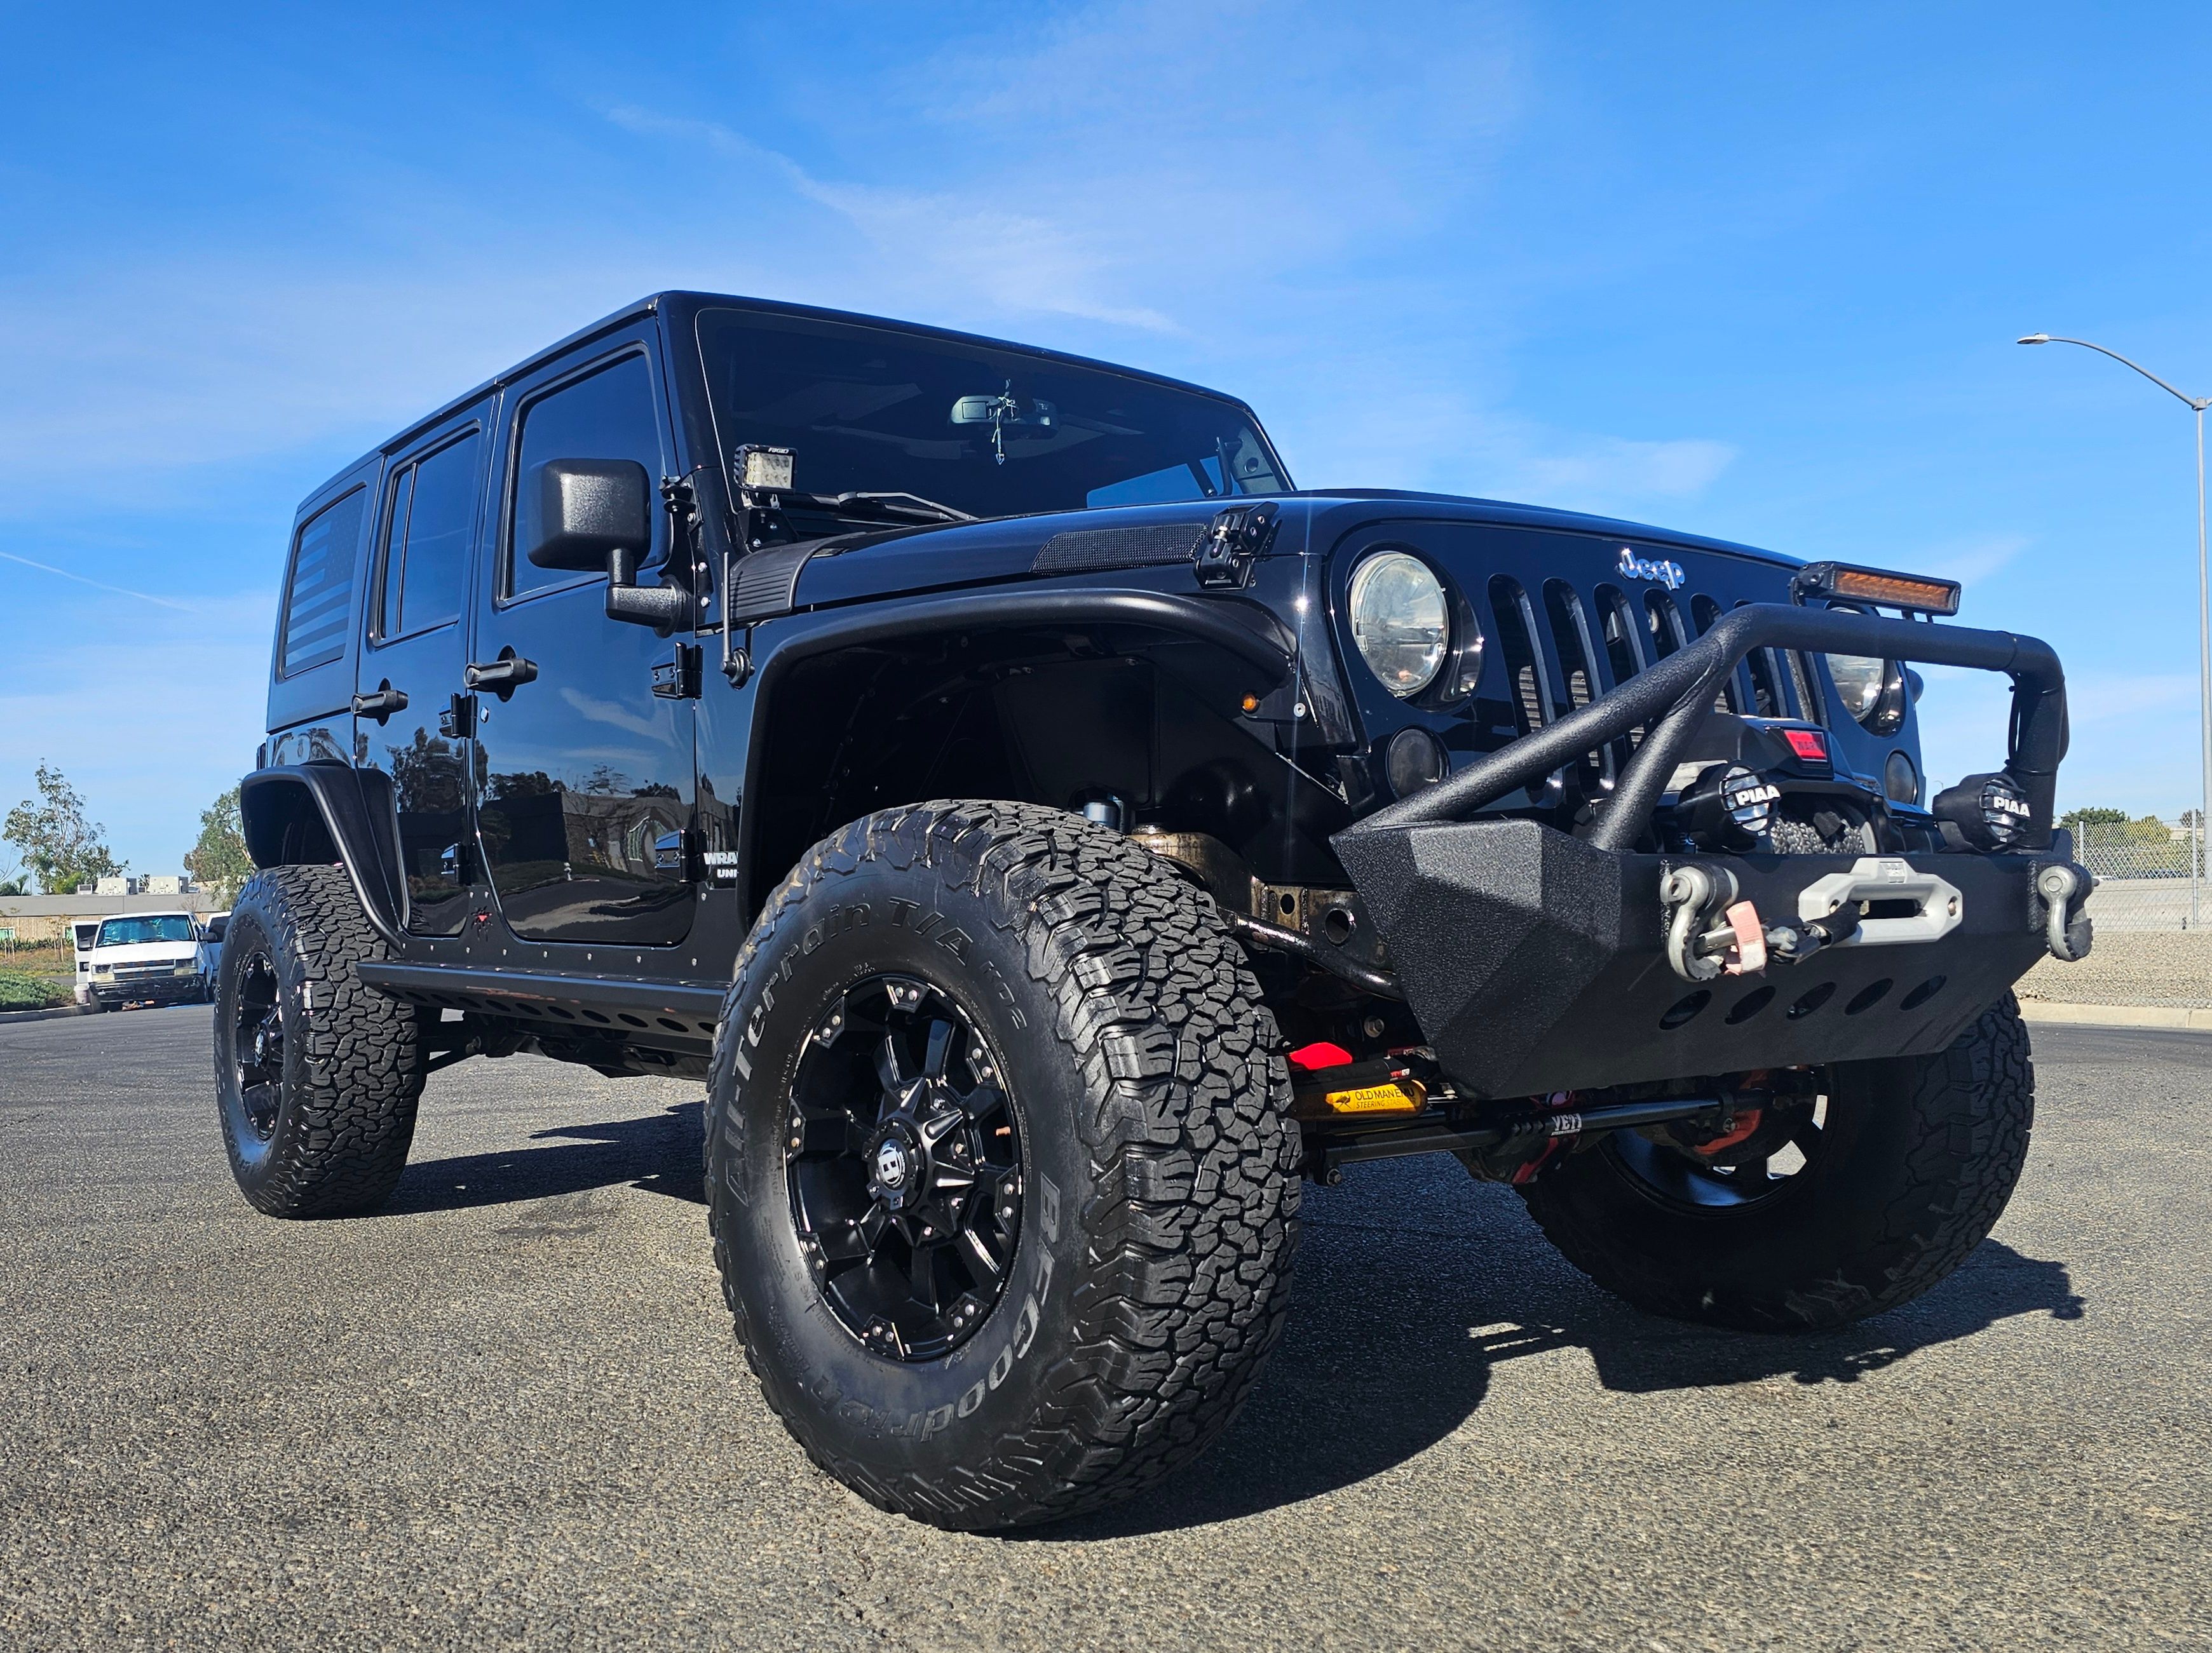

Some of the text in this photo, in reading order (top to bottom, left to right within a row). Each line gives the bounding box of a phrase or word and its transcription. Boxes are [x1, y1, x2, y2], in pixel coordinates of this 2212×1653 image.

[1618, 548, 1686, 591] Jeep
[1735, 784, 1781, 806] PIAA
[1993, 795, 2030, 818] PIAA
[703, 851, 738, 865] WRA
[1355, 1090, 1374, 1101] OLD
[1374, 1090, 1395, 1100] MAN
[1355, 1100, 1386, 1109] STEERING
[811, 1172, 1061, 1443] BFGoodrich
